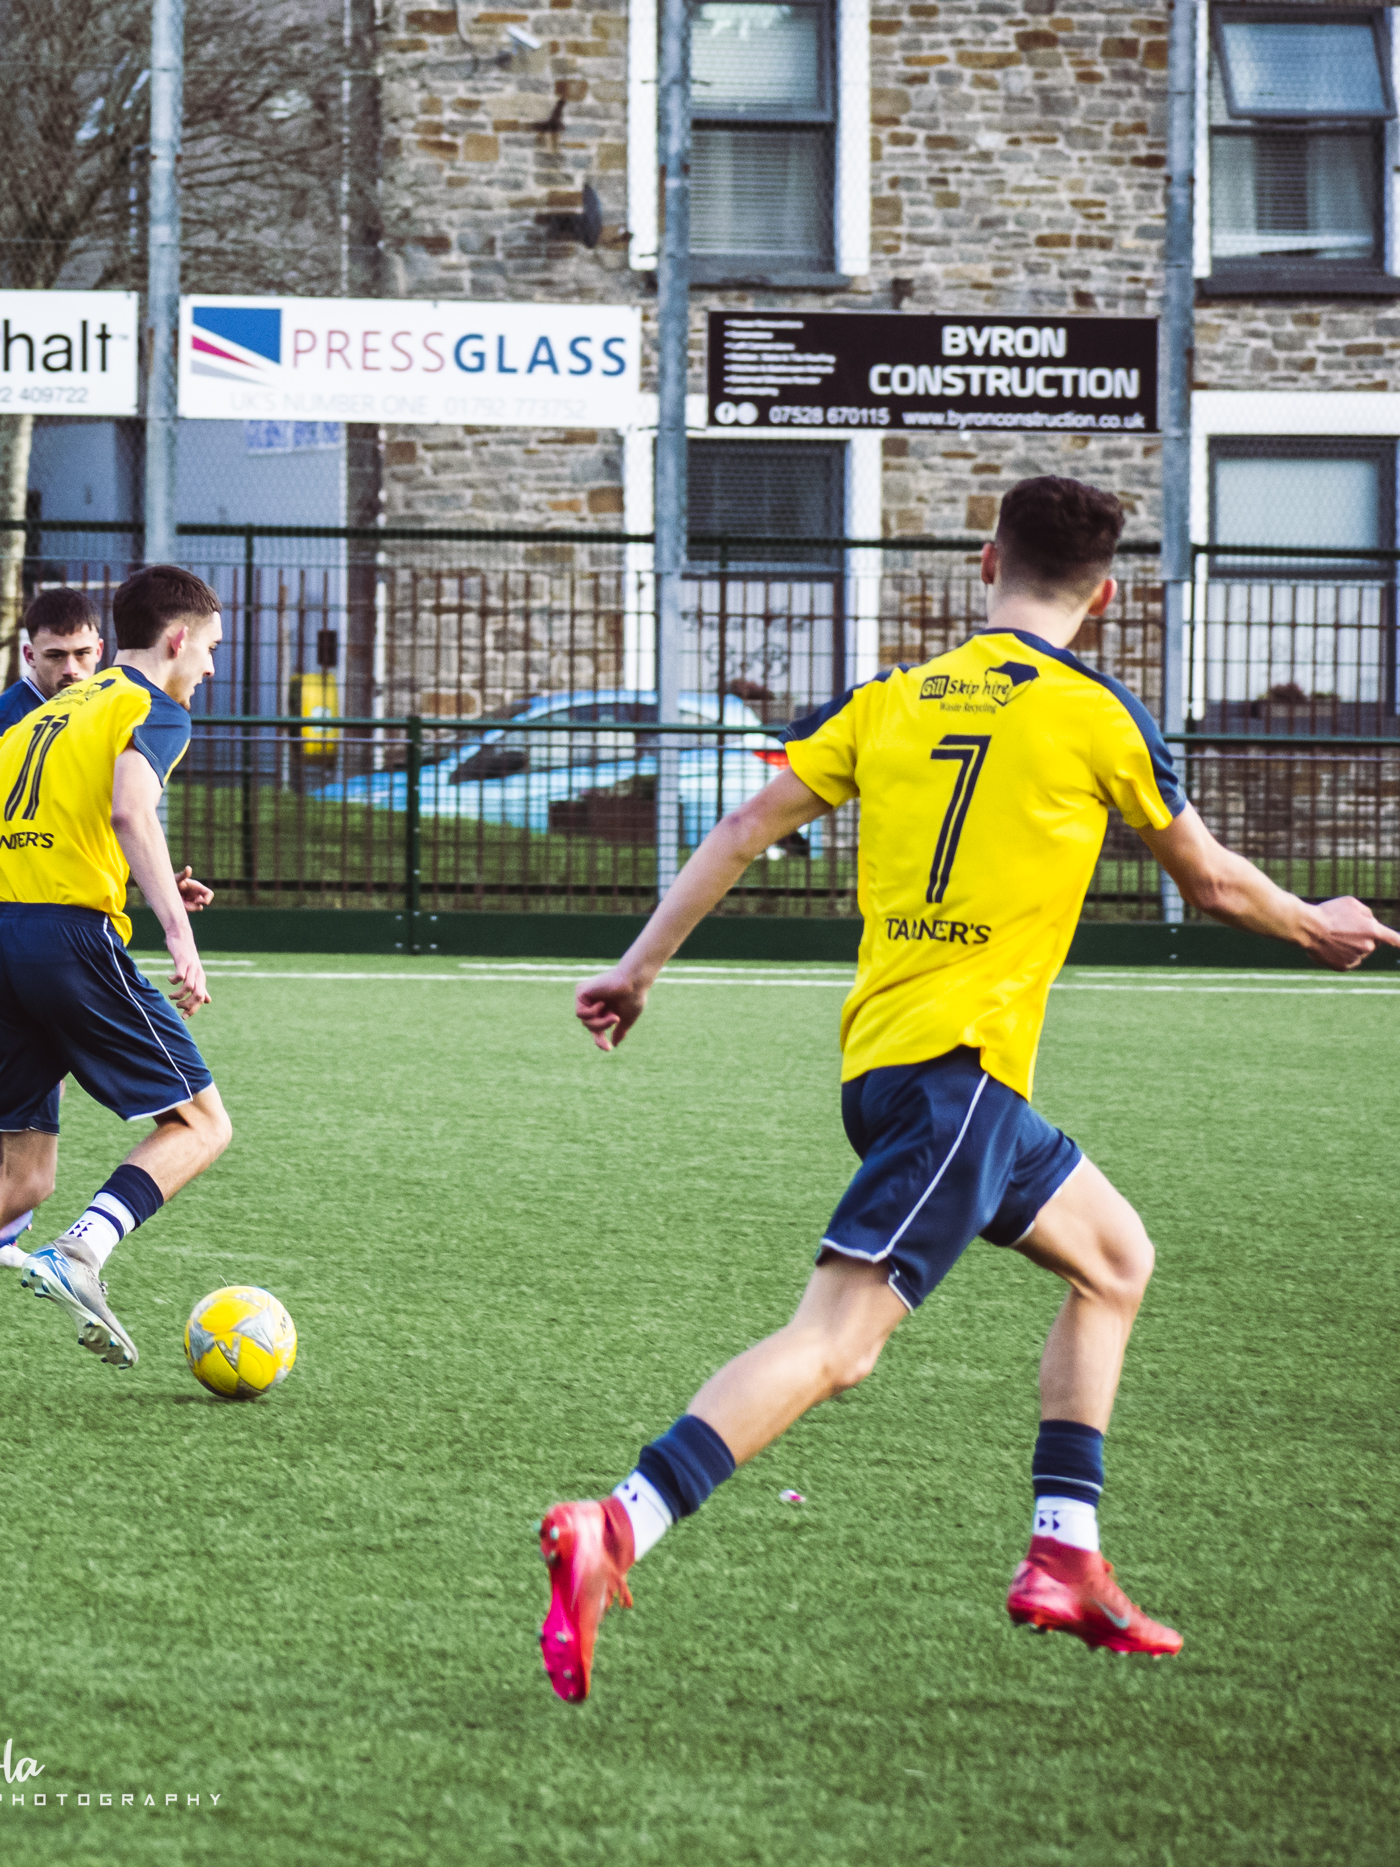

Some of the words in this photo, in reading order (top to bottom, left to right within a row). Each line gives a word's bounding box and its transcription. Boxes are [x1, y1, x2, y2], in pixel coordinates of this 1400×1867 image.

[293, 329, 627, 378] PRESSGLASS
[942, 325, 1067, 358] BYRON
[20, 387, 89, 404] 409722
[868, 364, 1141, 399] CONSTRUCTION
[229, 391, 276, 412] UK'S
[283, 393, 376, 414] NUMBER
[382, 394, 428, 416] ONE
[443, 396, 507, 418] 01792
[769, 405, 824, 425] 07528
[826, 406, 891, 426] 670115
[902, 409, 1146, 430] www.byronconstruction.co.uk
[948, 679, 980, 699] Skip
[982, 681, 1009, 696] hire
[963, 702, 998, 715] Recycling
[4, 712, 71, 822] 11
[925, 734, 992, 904] 7
